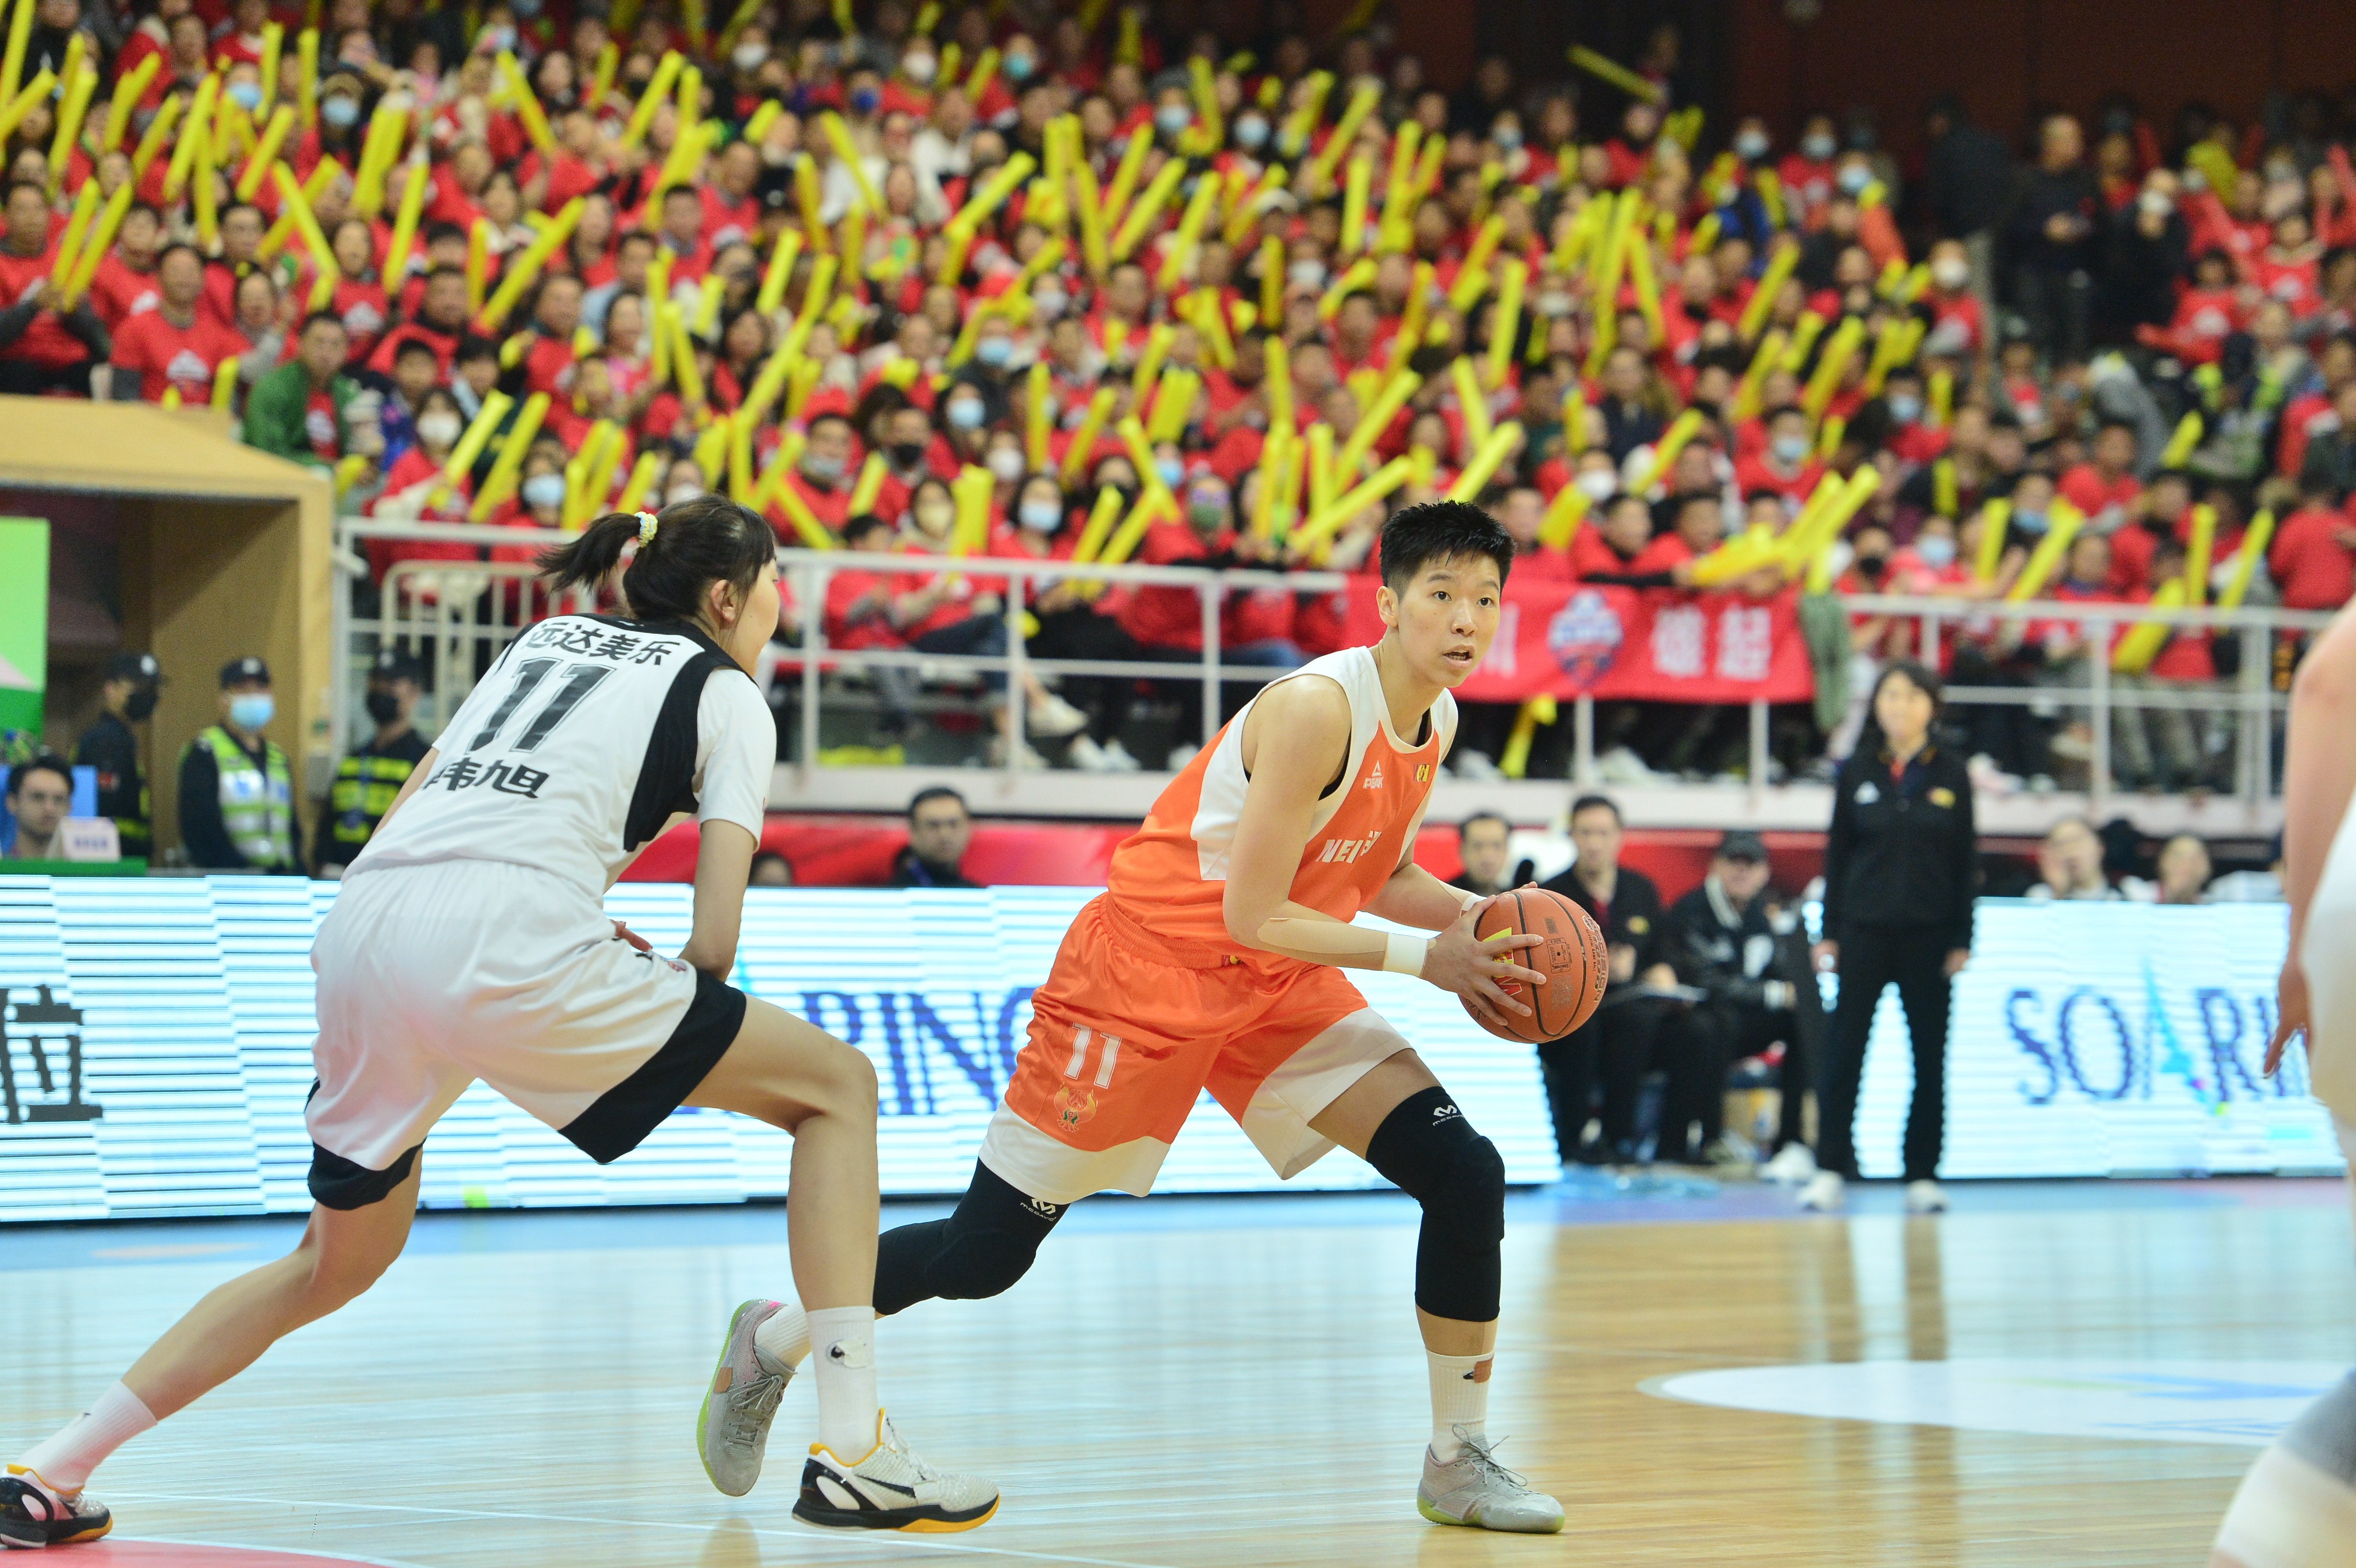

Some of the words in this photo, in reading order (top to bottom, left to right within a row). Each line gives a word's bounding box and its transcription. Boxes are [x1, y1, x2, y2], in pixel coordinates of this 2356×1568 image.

[523, 622, 680, 665] 远达美乐
[464, 657, 617, 754] 11
[1363, 776, 1384, 789] PEAK
[1064, 1022, 1122, 1089] 11
